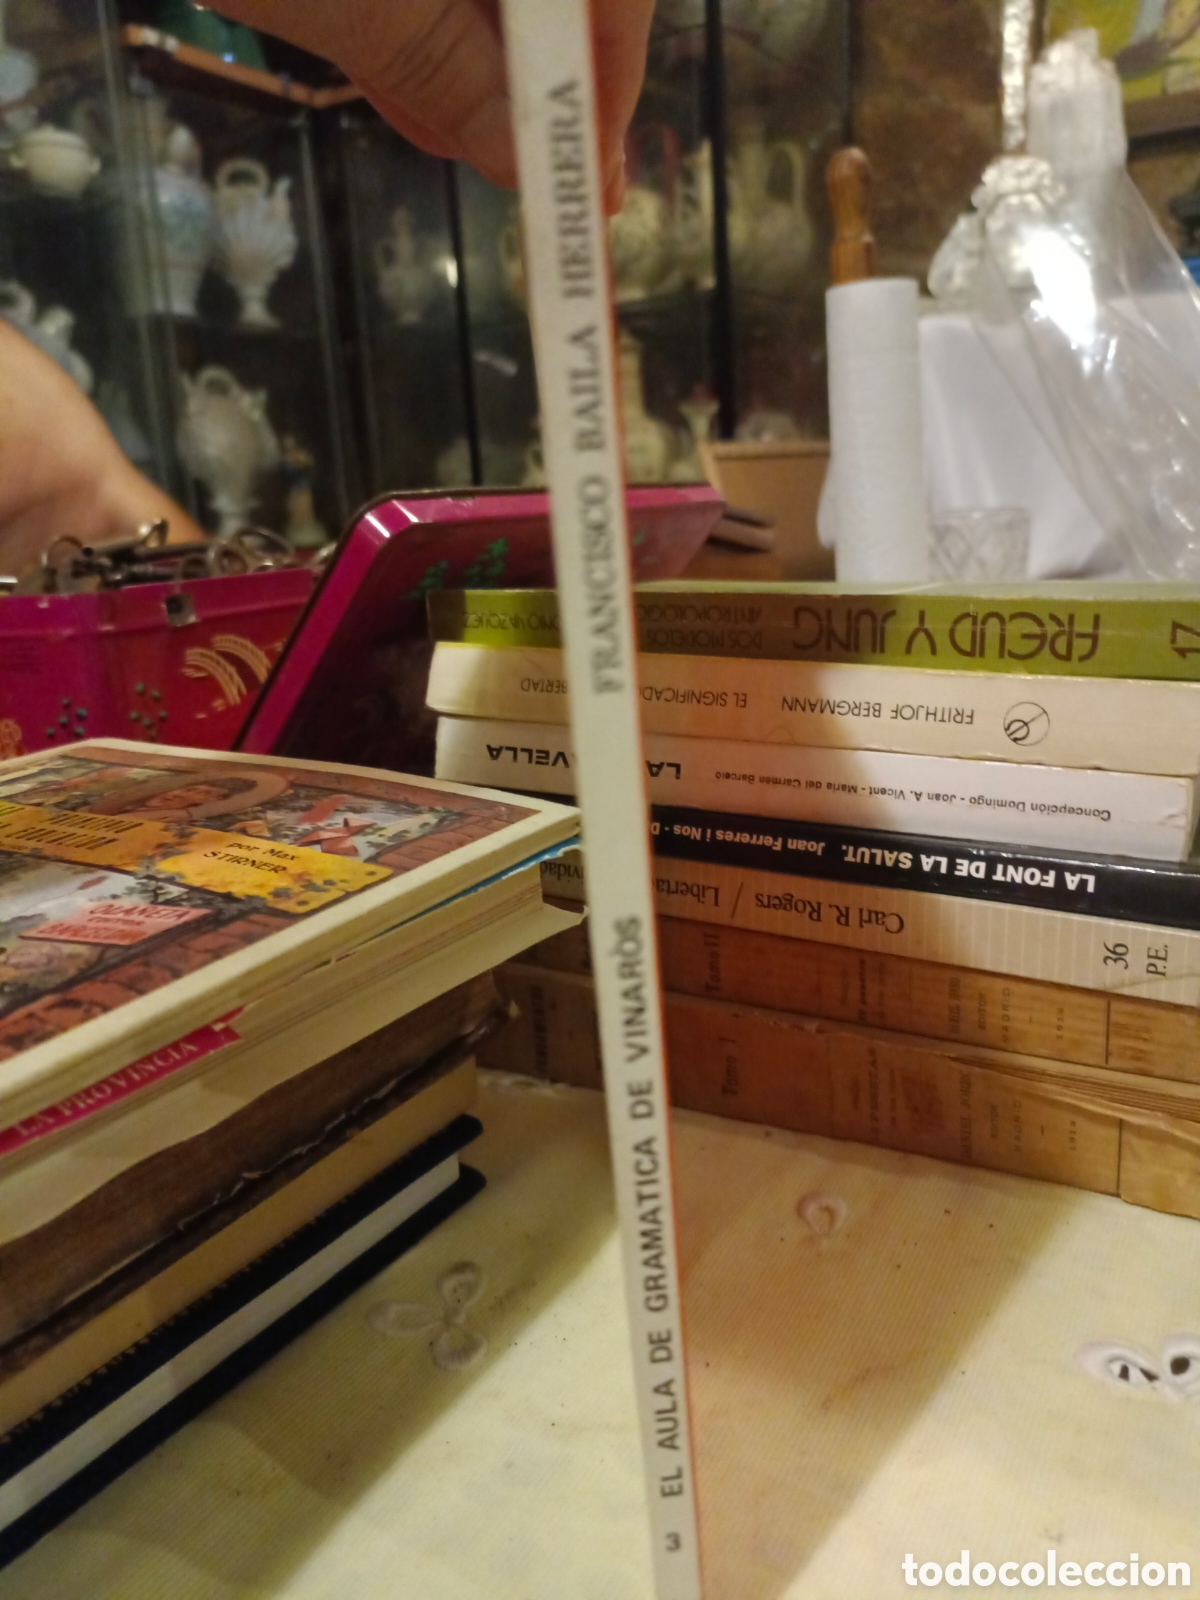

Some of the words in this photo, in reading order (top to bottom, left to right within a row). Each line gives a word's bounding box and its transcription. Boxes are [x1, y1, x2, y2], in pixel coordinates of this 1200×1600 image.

[548, 79, 594, 298] HERRERA
[567, 325, 607, 452] BAILA
[578, 475, 625, 695] FRANCISCO
[637, 604, 763, 625] ANTROPOLOGIC
[647, 628, 723, 648] MODELOS
[792, 606, 897, 655] JUNG
[905, 610, 937, 656] Y
[949, 611, 1100, 663] FREUD
[637, 686, 729, 707] SIGNIFICAD
[735, 692, 748, 708] EL
[781, 696, 882, 718] BERGMANN
[890, 703, 975, 725] FRITHJOF
[486, 744, 570, 768] VELLA
[759, 775, 801, 789] Carmen
[805, 778, 822, 791] del
[868, 785, 905, 800] Vicent
[927, 791, 956, 803] Joan
[969, 795, 1026, 813] Domingo
[1031, 803, 1112, 822] Concepción
[673, 825, 702, 841] Nos
[716, 830, 783, 851] Ferreres
[228, 840, 260, 854] por
[264, 846, 301, 862] Max
[787, 840, 826, 856] Joan
[841, 844, 914, 869] SALUT.
[202, 850, 288, 875] STIRNER
[920, 853, 948, 874] LA
[953, 857, 986, 880] DE
[991, 862, 1056, 888] FONT
[1064, 871, 1096, 893] LA
[653, 877, 721, 907] Liberta
[755, 892, 823, 923] Rogers
[828, 904, 851, 927] R.
[859, 907, 906, 934] Carl
[1102, 941, 1130, 970] 36
[15, 1104, 54, 1137] LA
[59, 1038, 199, 1118] PROVINCIA
[628, 1079, 656, 1120] DE
[632, 1137, 670, 1313] GRAMATICA
[648, 1328, 674, 1365] DE
[652, 1377, 681, 1452] AULA
[660, 1466, 684, 1498] EL
